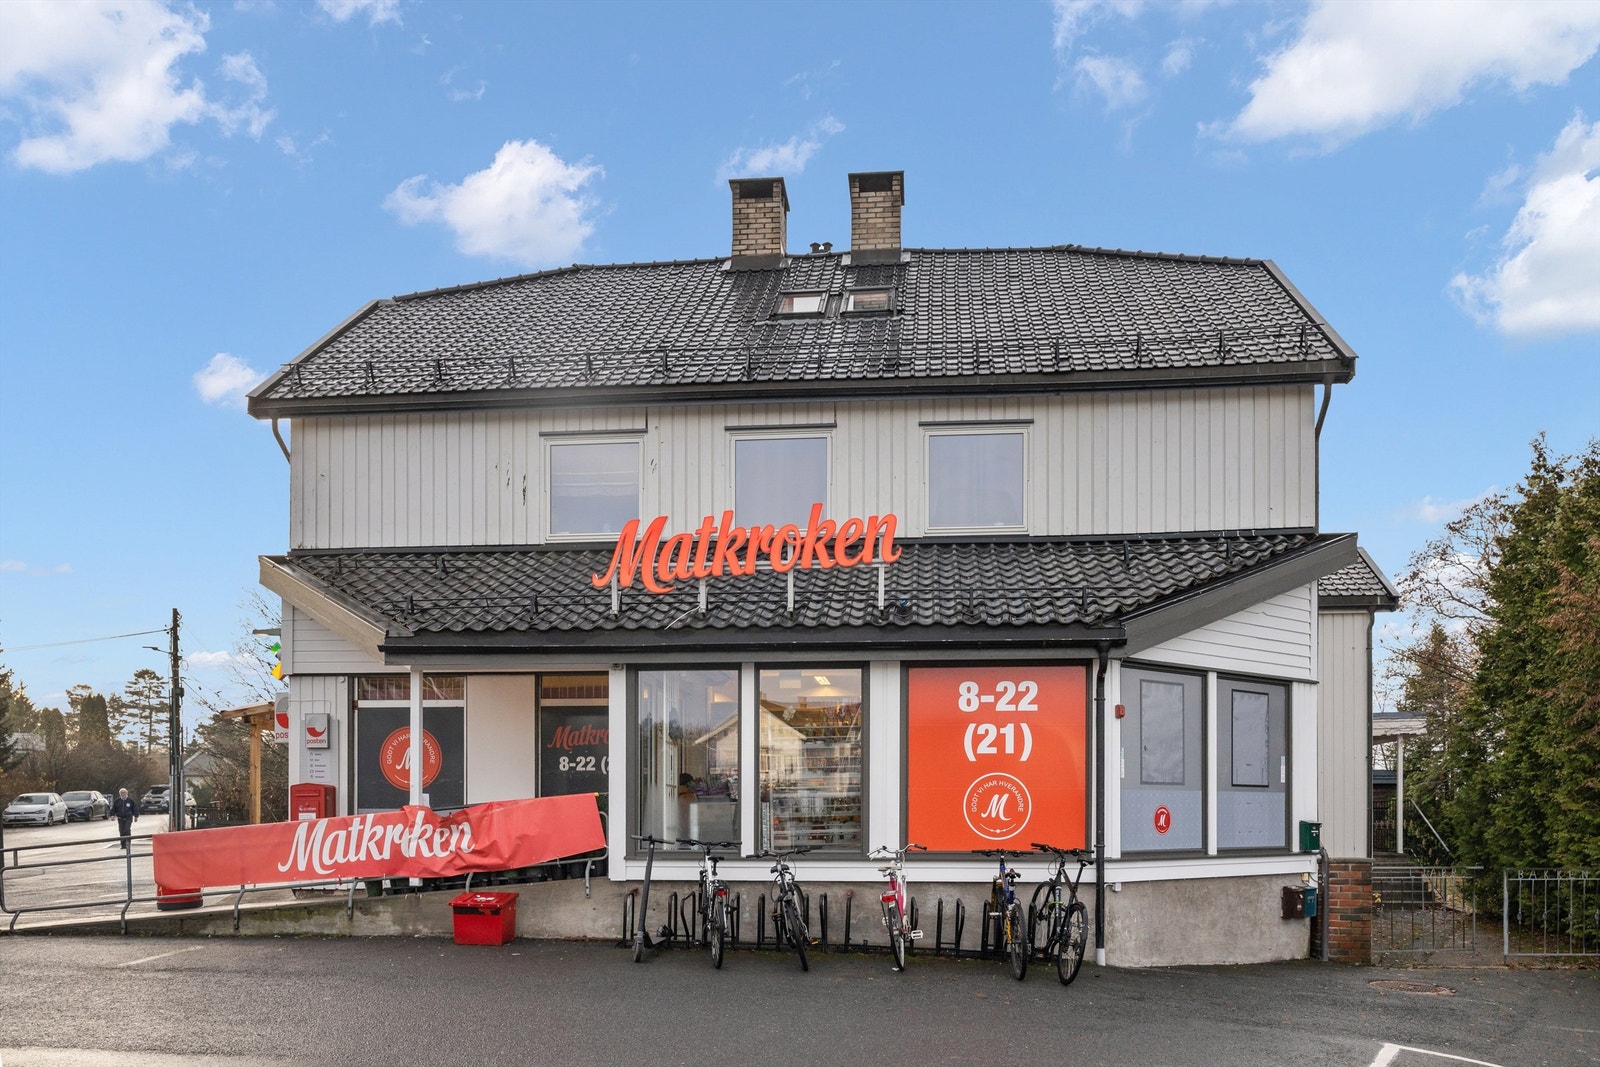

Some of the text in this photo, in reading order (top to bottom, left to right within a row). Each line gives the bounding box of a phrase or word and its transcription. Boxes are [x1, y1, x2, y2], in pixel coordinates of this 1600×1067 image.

[592, 503, 902, 593] Matkroken
[958, 681, 1038, 712] 8-22
[275, 732, 289, 740] pos
[964, 723, 1033, 761] (21)
[387, 745, 395, 765] GODT
[559, 756, 596, 771] 8-22
[971, 792, 980, 813] GODT
[983, 780, 998, 789] HAR
[998, 780, 1024, 812] HVERANDRE
[981, 793, 1012, 821] M
[278, 810, 475, 875] Matkroken
